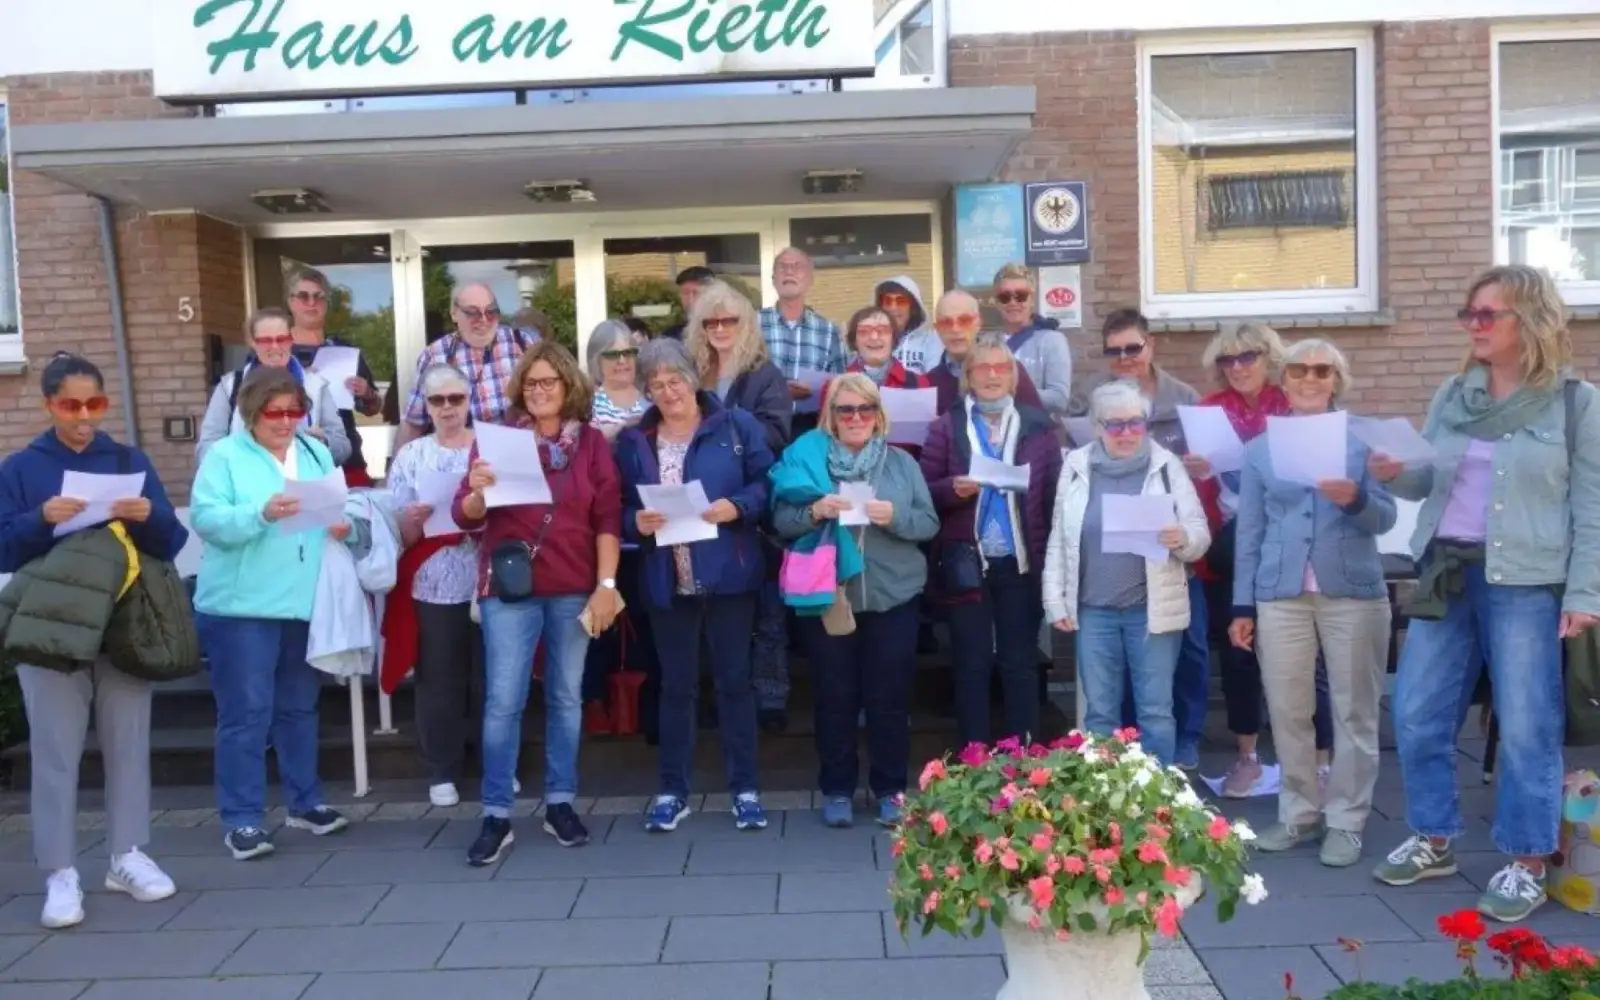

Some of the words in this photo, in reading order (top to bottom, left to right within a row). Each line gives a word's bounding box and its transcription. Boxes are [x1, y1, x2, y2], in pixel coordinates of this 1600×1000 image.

[193, 0, 420, 74] Haus
[451, 13, 573, 64] am
[609, 0, 831, 61] Rieth
[178, 296, 195, 322] 5
